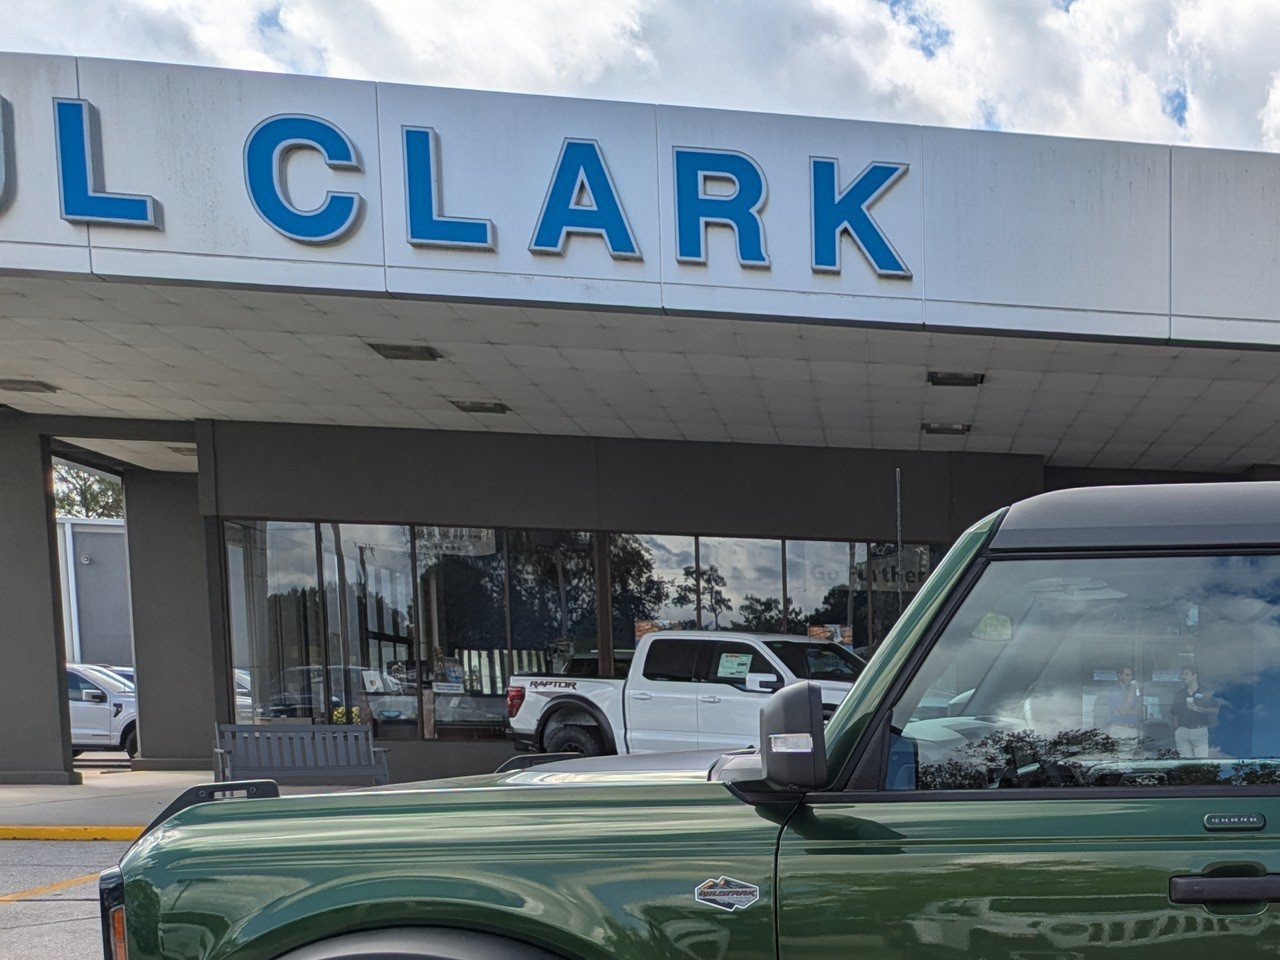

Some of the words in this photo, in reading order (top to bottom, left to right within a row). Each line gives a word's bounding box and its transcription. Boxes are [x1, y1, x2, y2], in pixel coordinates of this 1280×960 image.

[0, 94, 163, 231] L
[245, 112, 913, 280] CLARK
[810, 564, 839, 580] Go
[851, 565, 926, 584] urther
[530, 681, 577, 690] RAPTOR
